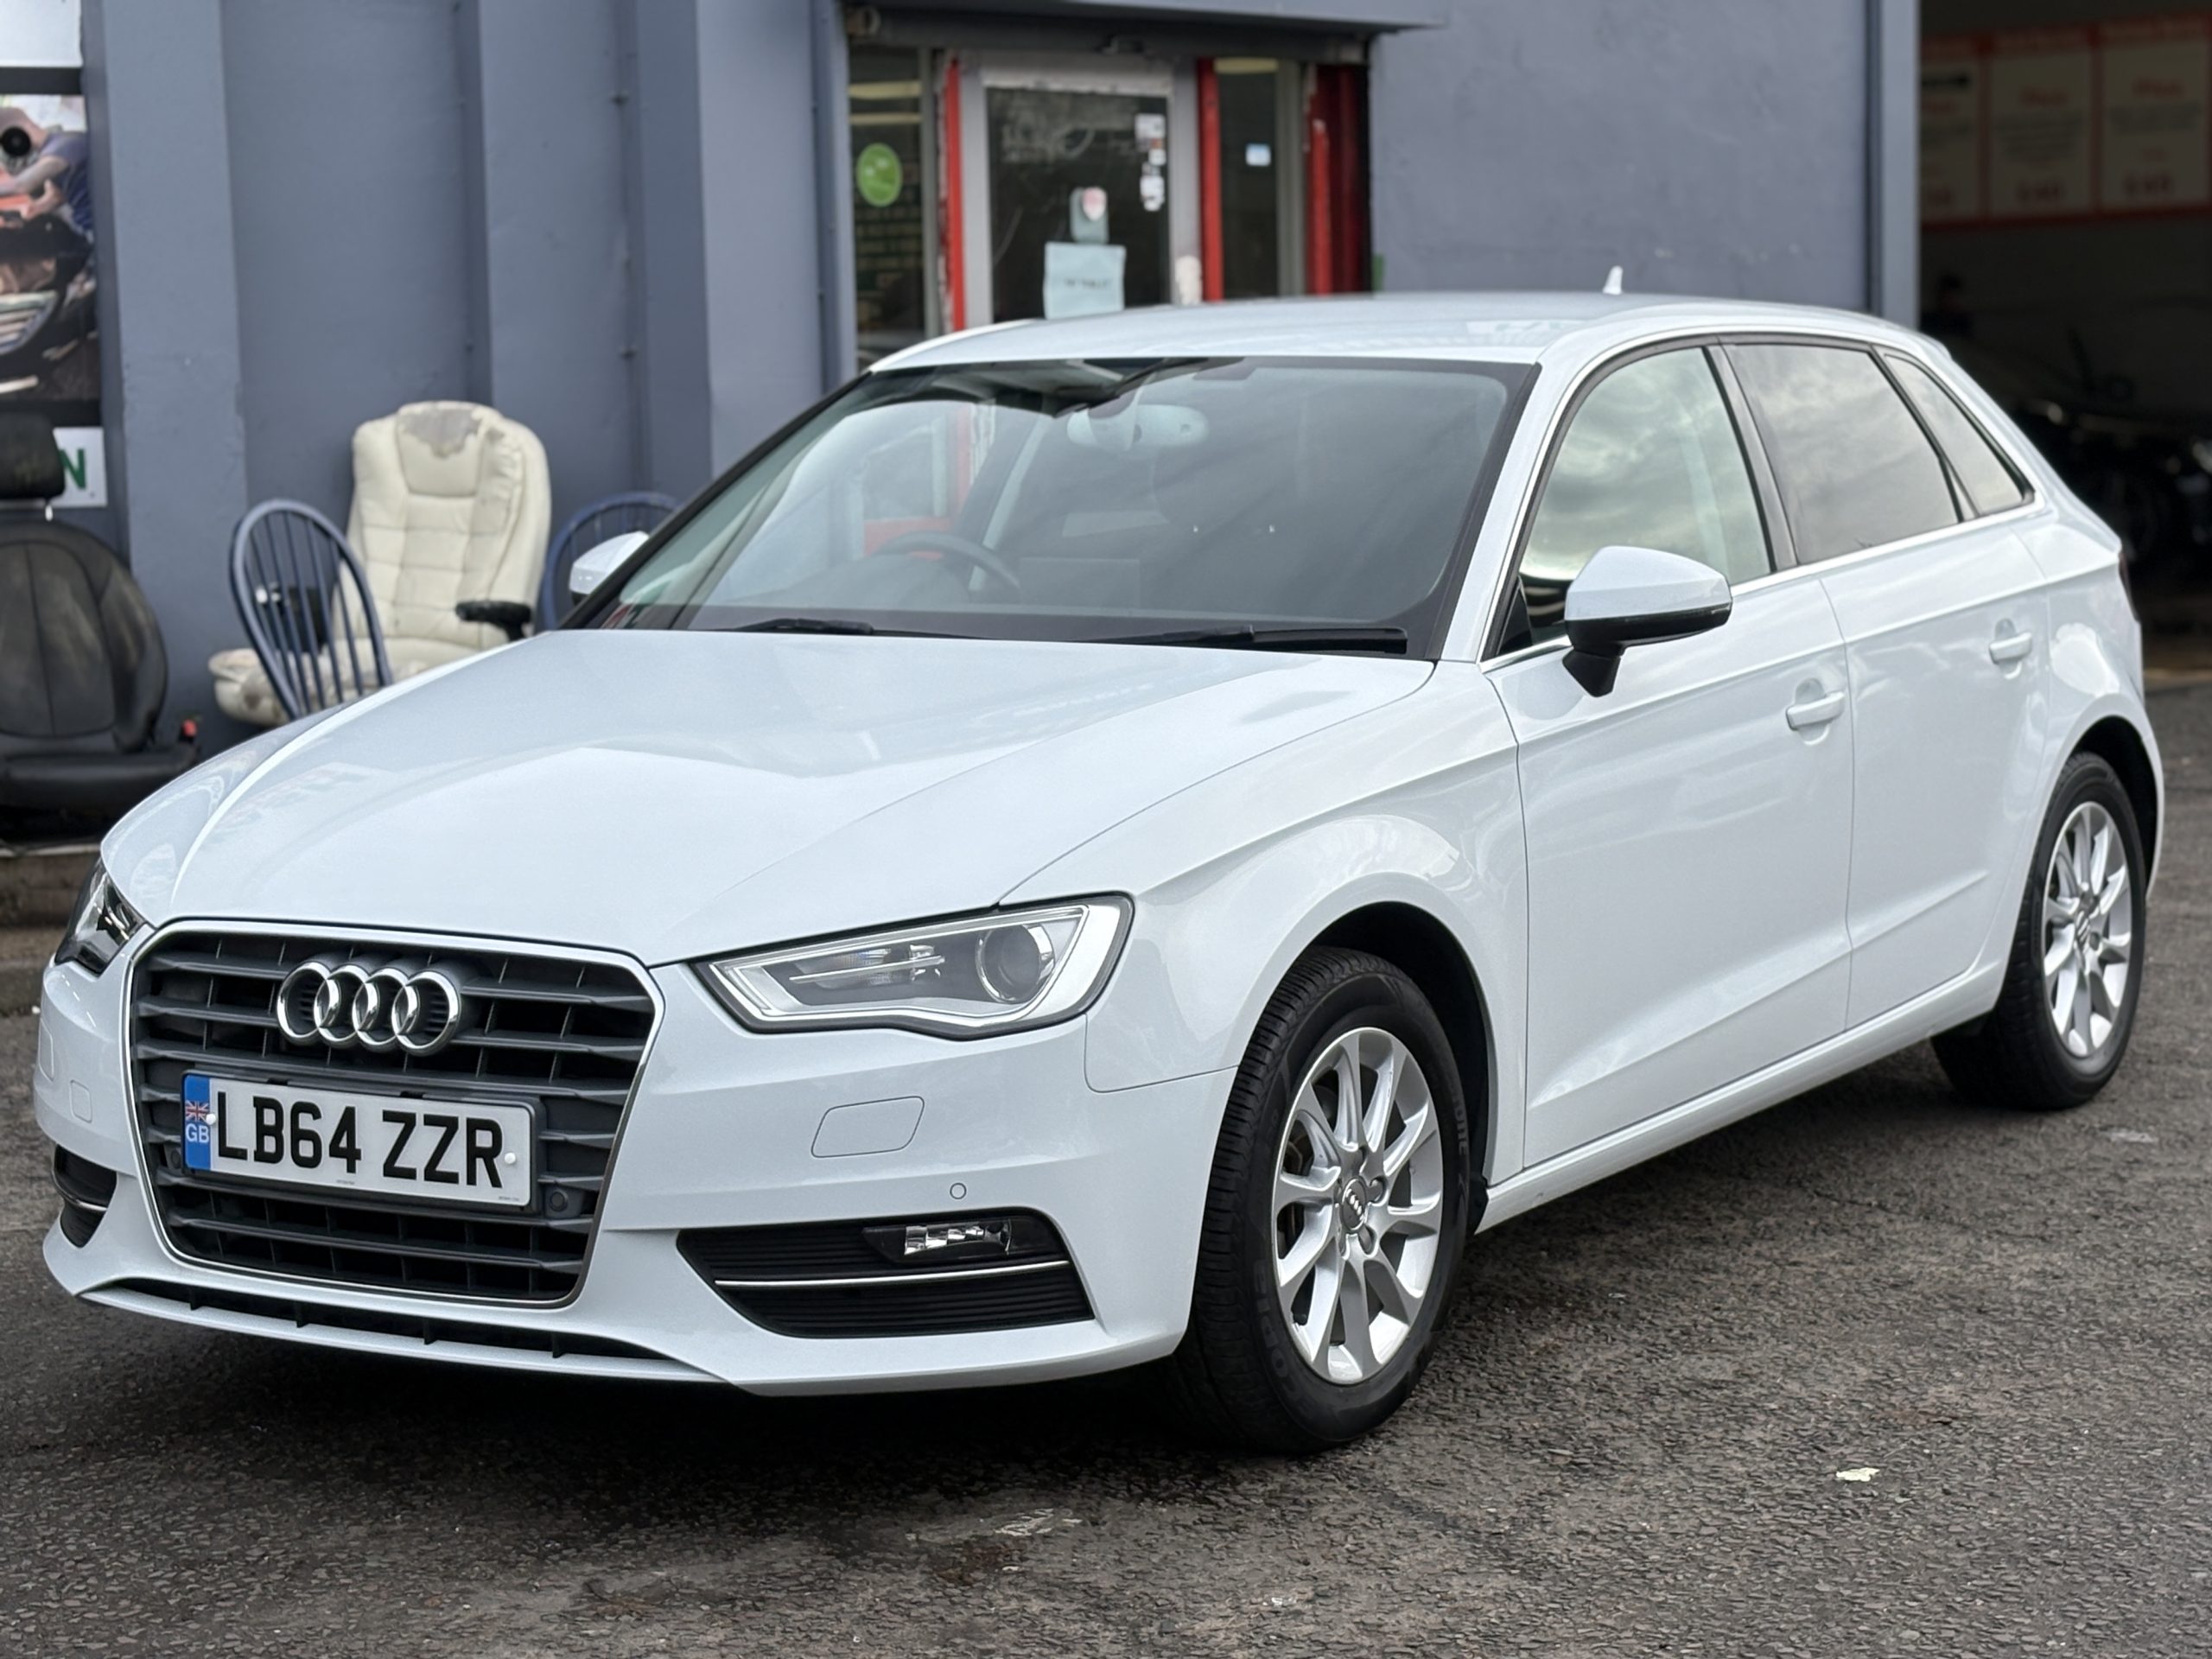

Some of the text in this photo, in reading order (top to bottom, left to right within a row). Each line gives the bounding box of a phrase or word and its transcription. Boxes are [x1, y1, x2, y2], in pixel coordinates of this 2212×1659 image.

[186, 1122, 210, 1144] GB
[217, 1091, 504, 1189] LB64 ZZR
